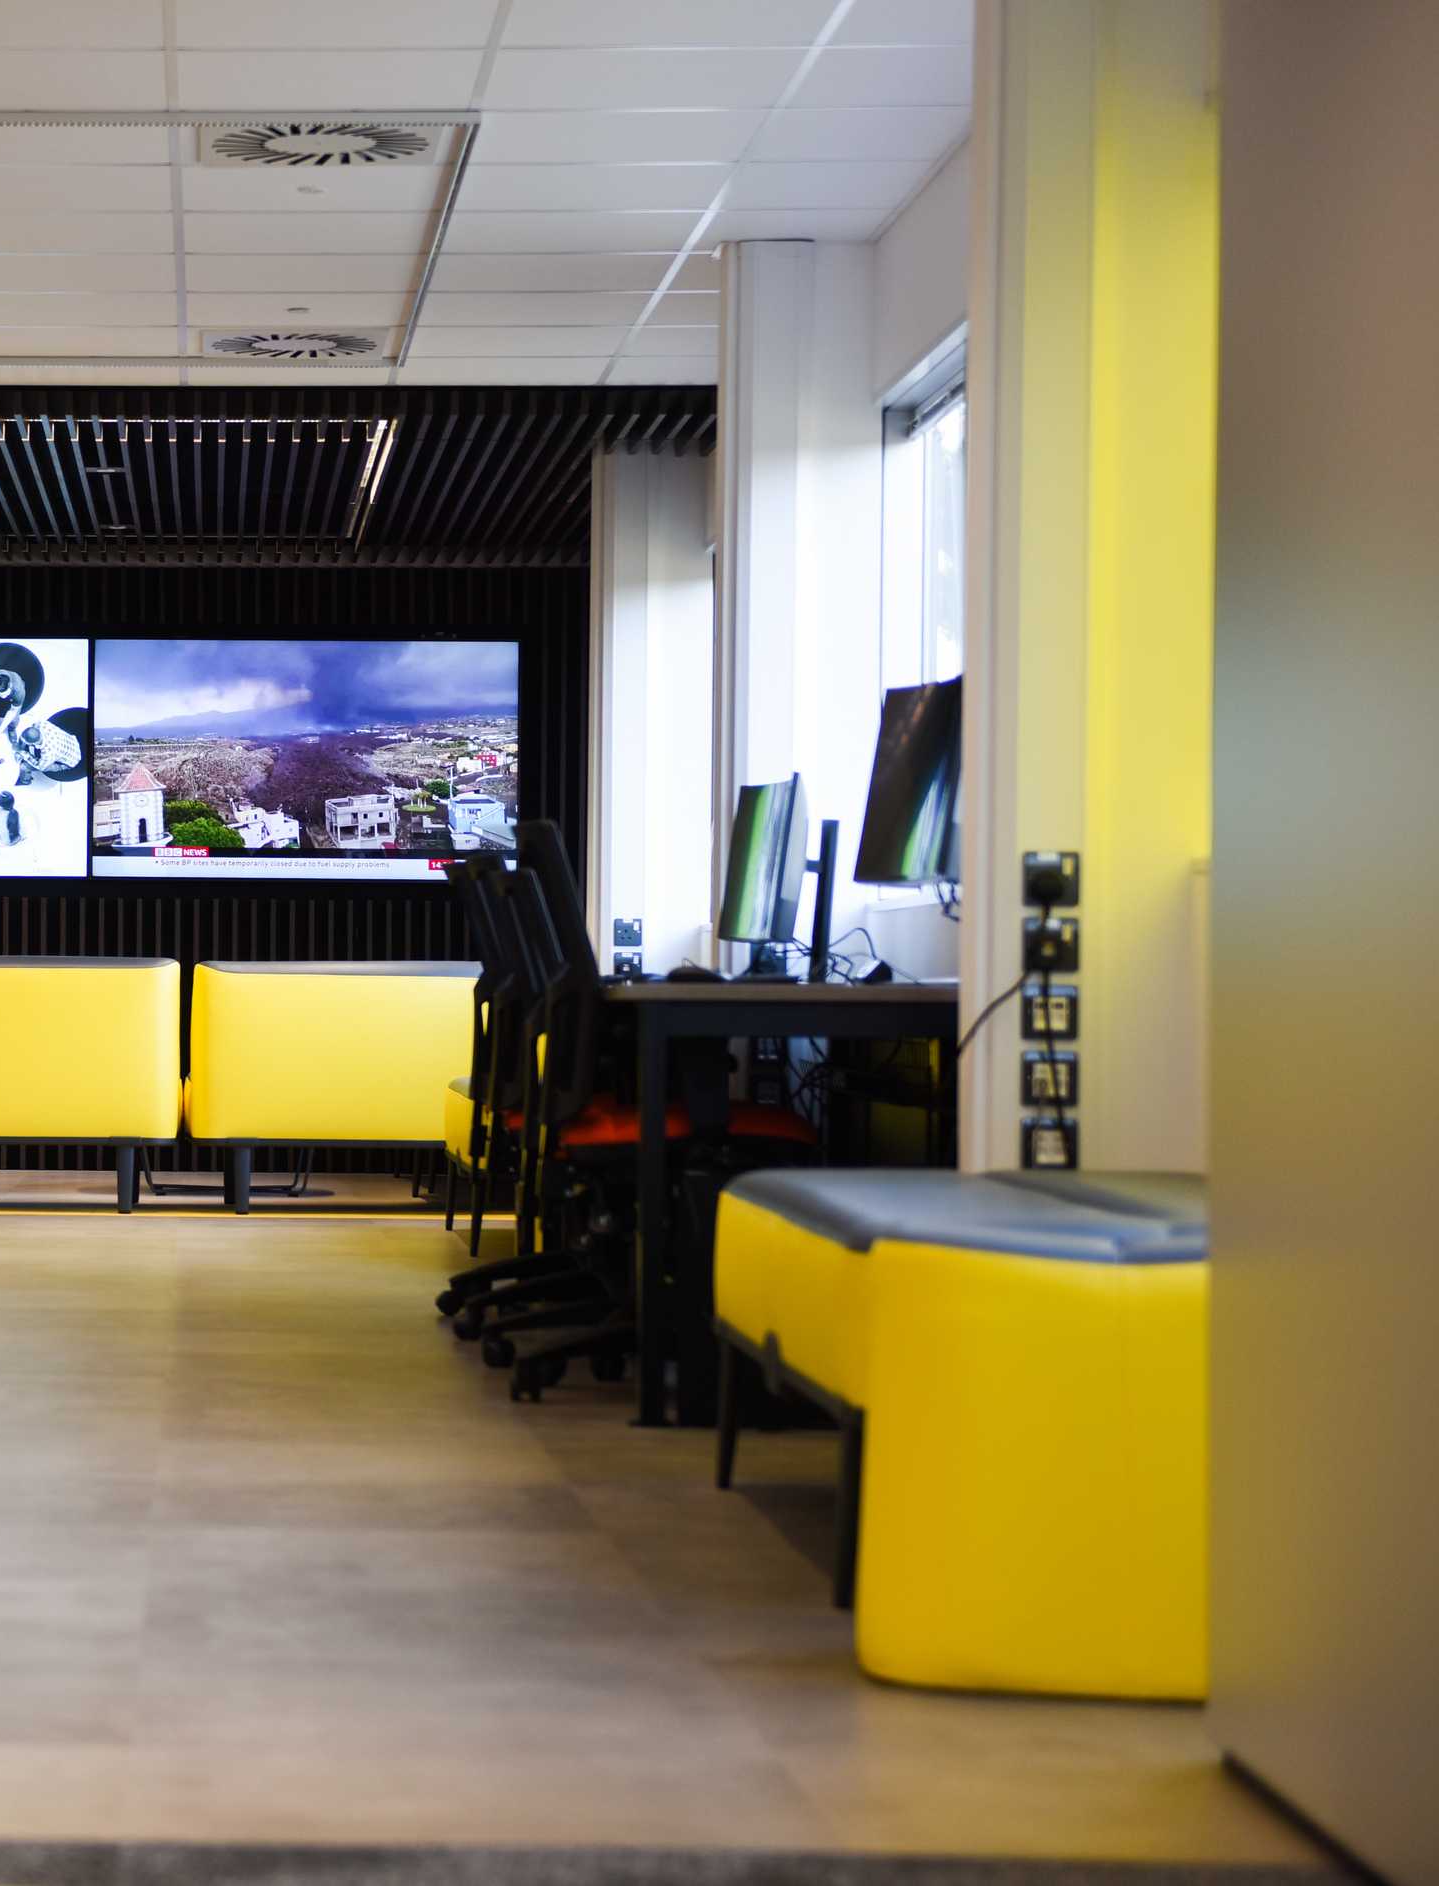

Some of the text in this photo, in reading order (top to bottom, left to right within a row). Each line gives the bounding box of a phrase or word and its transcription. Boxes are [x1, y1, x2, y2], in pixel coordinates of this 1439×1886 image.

[154, 847, 208, 857] BBC NEWS
[160, 858, 180, 866] Some
[210, 859, 227, 867] have
[228, 859, 269, 869] temporarily
[293, 859, 307, 868] due
[317, 860, 332, 868] fuel
[332, 861, 355, 870] supply
[356, 860, 391, 870] problems
